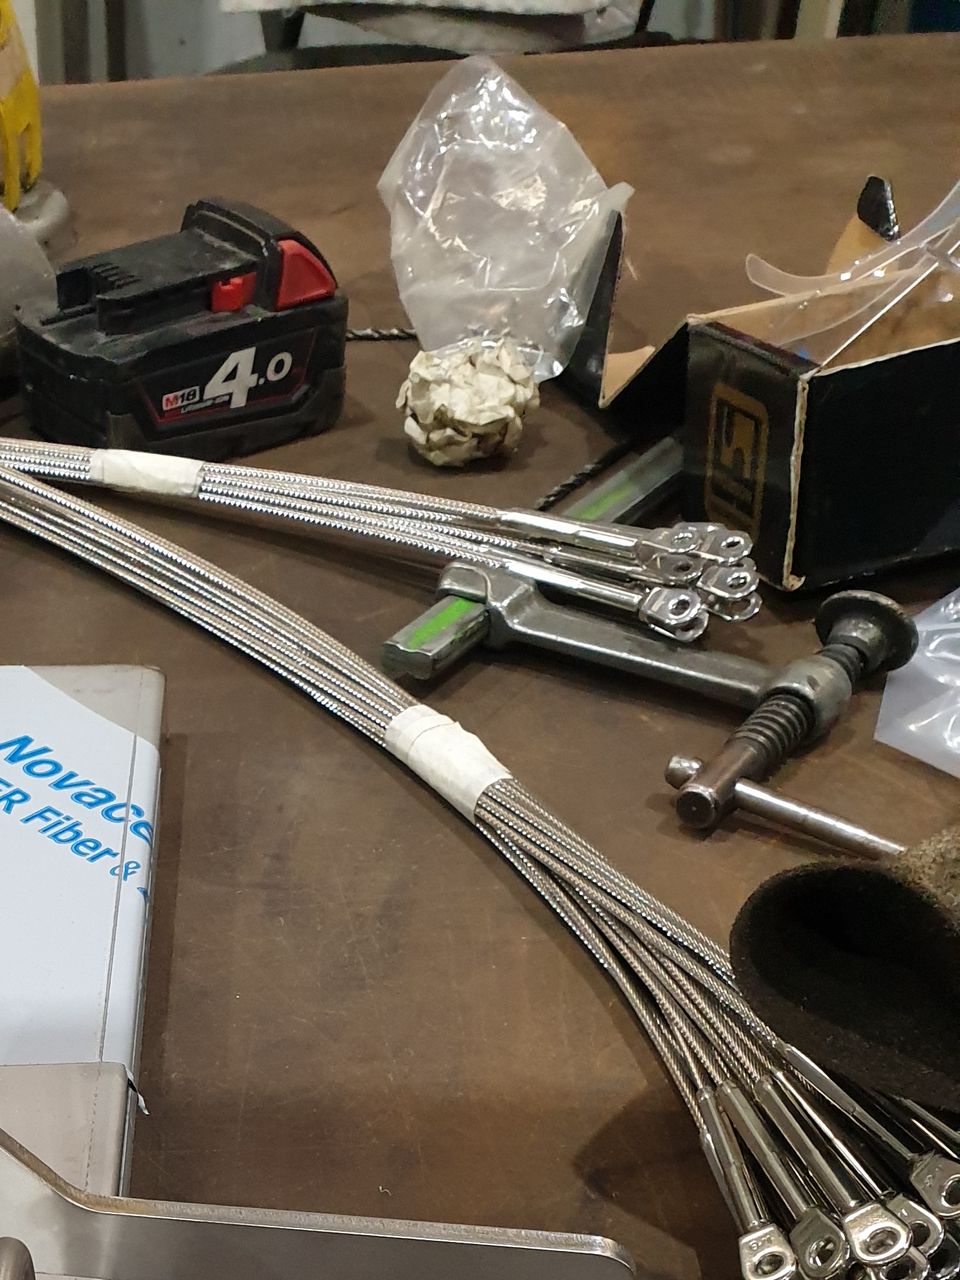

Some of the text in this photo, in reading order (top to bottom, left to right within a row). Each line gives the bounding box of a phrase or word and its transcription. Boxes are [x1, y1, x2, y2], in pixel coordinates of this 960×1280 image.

[165, 389, 198, 407] M18
[203, 346, 293, 409] 4.0
[20, 805, 120, 863] Fiber
